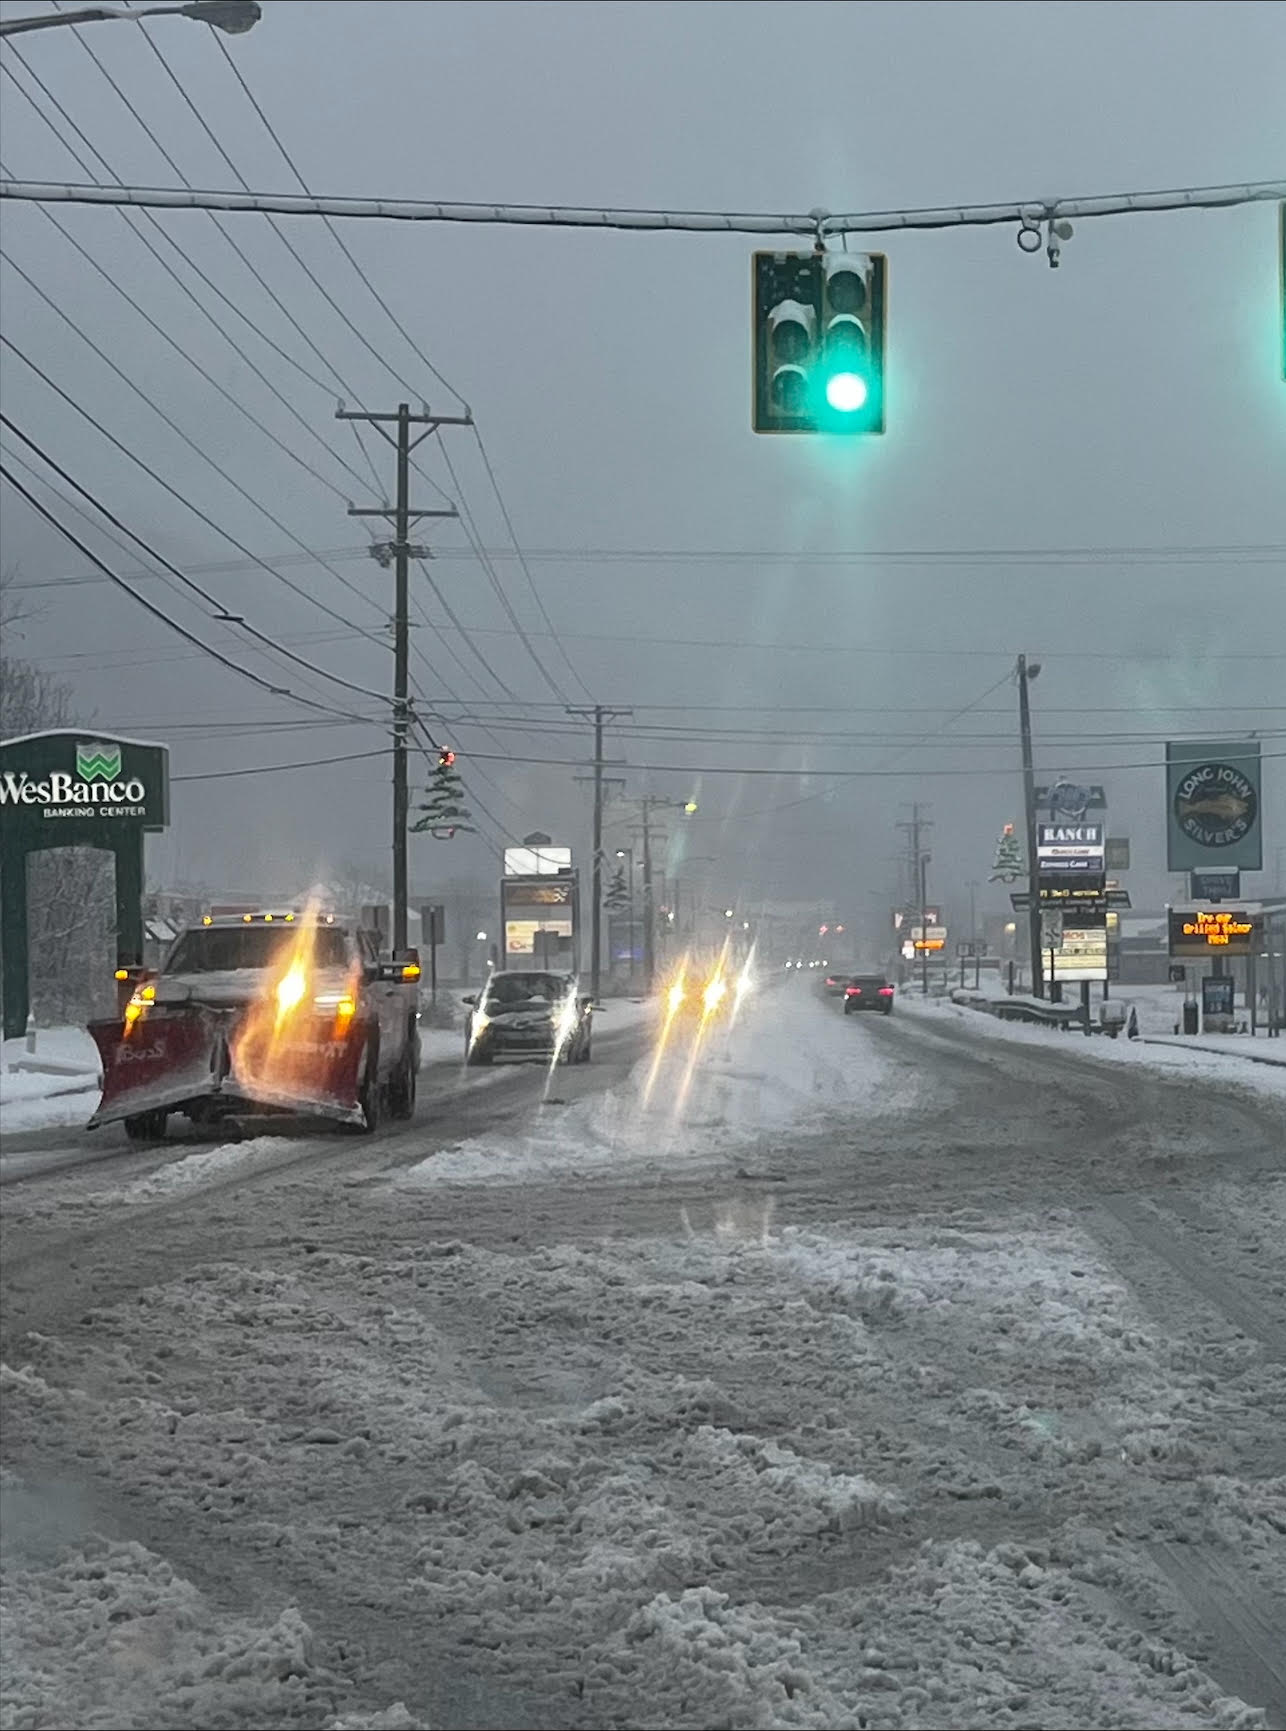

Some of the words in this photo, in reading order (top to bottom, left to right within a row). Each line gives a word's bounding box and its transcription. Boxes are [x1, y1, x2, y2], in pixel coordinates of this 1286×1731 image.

[1218, 768, 1252, 798] JOHN
[44, 807, 94, 818] BANKING
[100, 806, 146, 817] CENTER
[1044, 828, 1097, 841] RANCH
